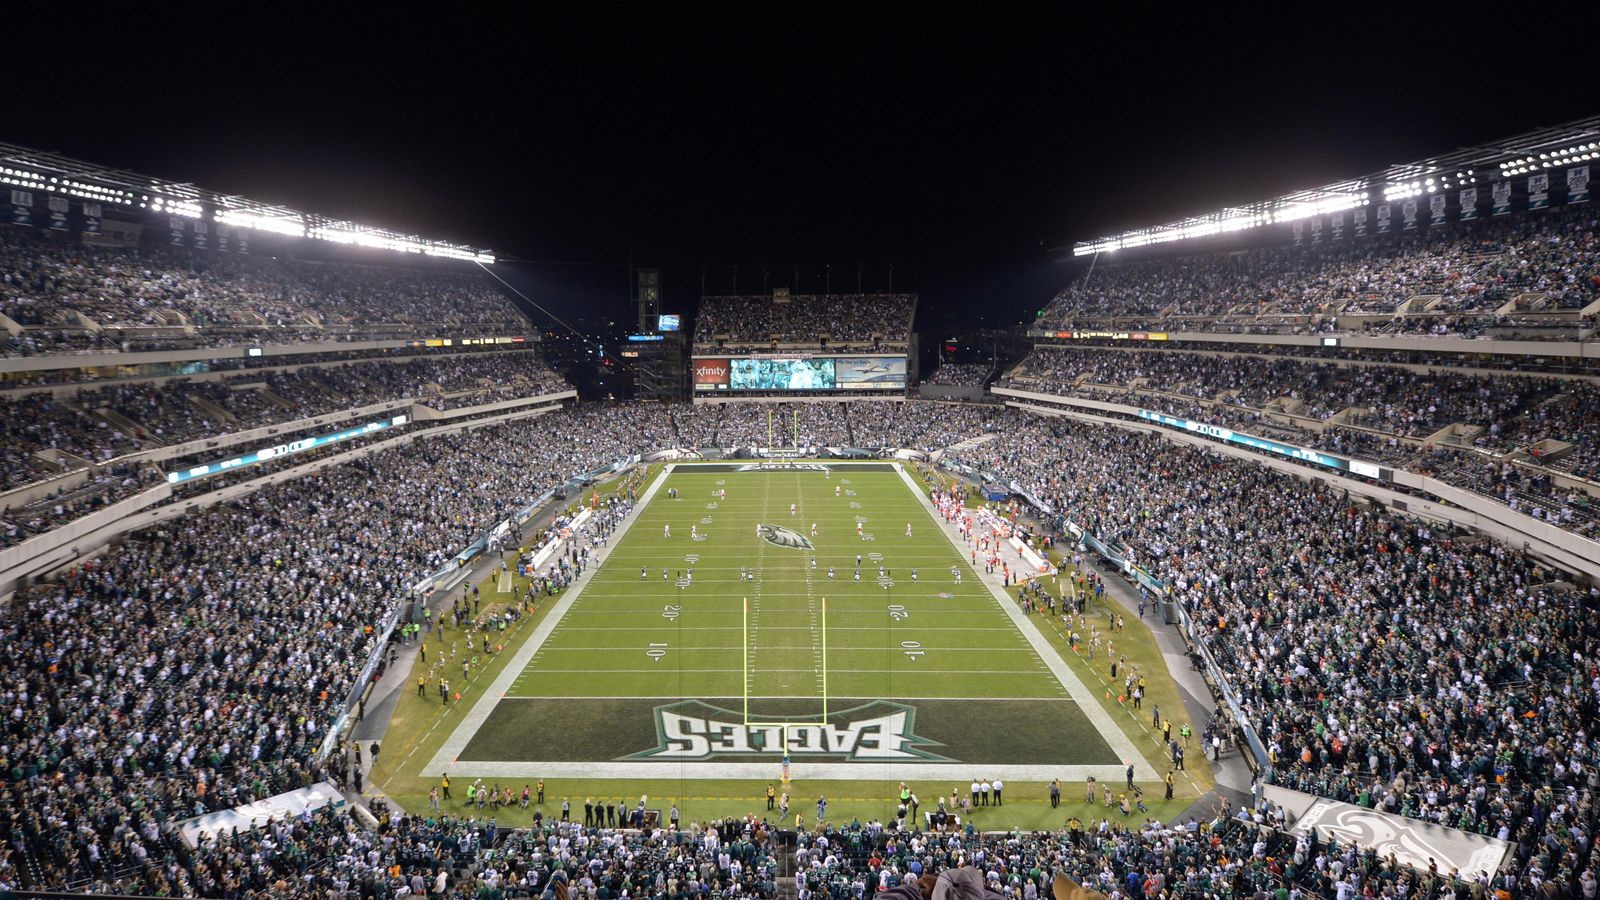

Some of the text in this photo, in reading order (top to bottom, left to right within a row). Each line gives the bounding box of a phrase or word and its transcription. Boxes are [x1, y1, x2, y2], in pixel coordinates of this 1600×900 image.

[696, 366, 727, 377] xfinity
[662, 605, 682, 618] 20
[887, 604, 908, 617] 20
[646, 642, 668, 657] 10
[901, 641, 925, 656] 10
[648, 709, 923, 758] EAGLES
